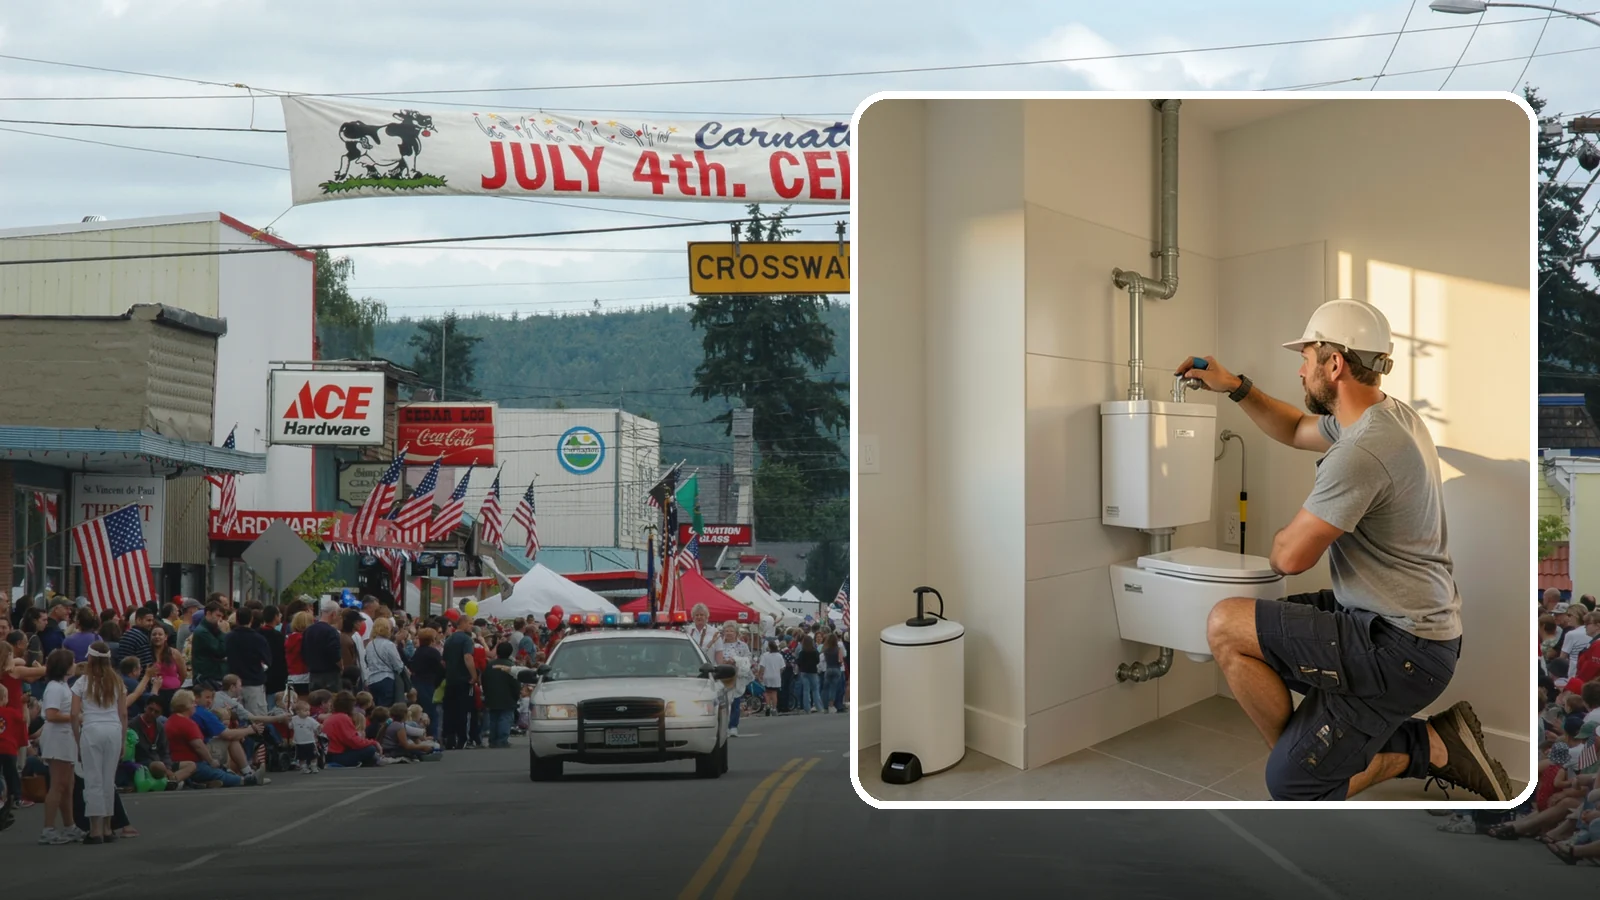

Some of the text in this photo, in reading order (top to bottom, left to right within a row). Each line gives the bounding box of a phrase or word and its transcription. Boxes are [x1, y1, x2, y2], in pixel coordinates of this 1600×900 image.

[481, 141, 605, 193] JULY
[632, 150, 746, 197] 4th.
[697, 254, 850, 280] CROSSWA
[283, 380, 373, 420] ACE
[405, 409, 452, 422] CEDAR
[283, 421, 371, 437] Hardware
[353, 467, 384, 481] Simpl
[95, 484, 124, 495] Vincent
[126, 485, 135, 495] de
[137, 485, 155, 495] Paul
[212, 515, 331, 536] HARDARE
[688, 526, 741, 535] CRNATION
[698, 535, 730, 543] GLASS
